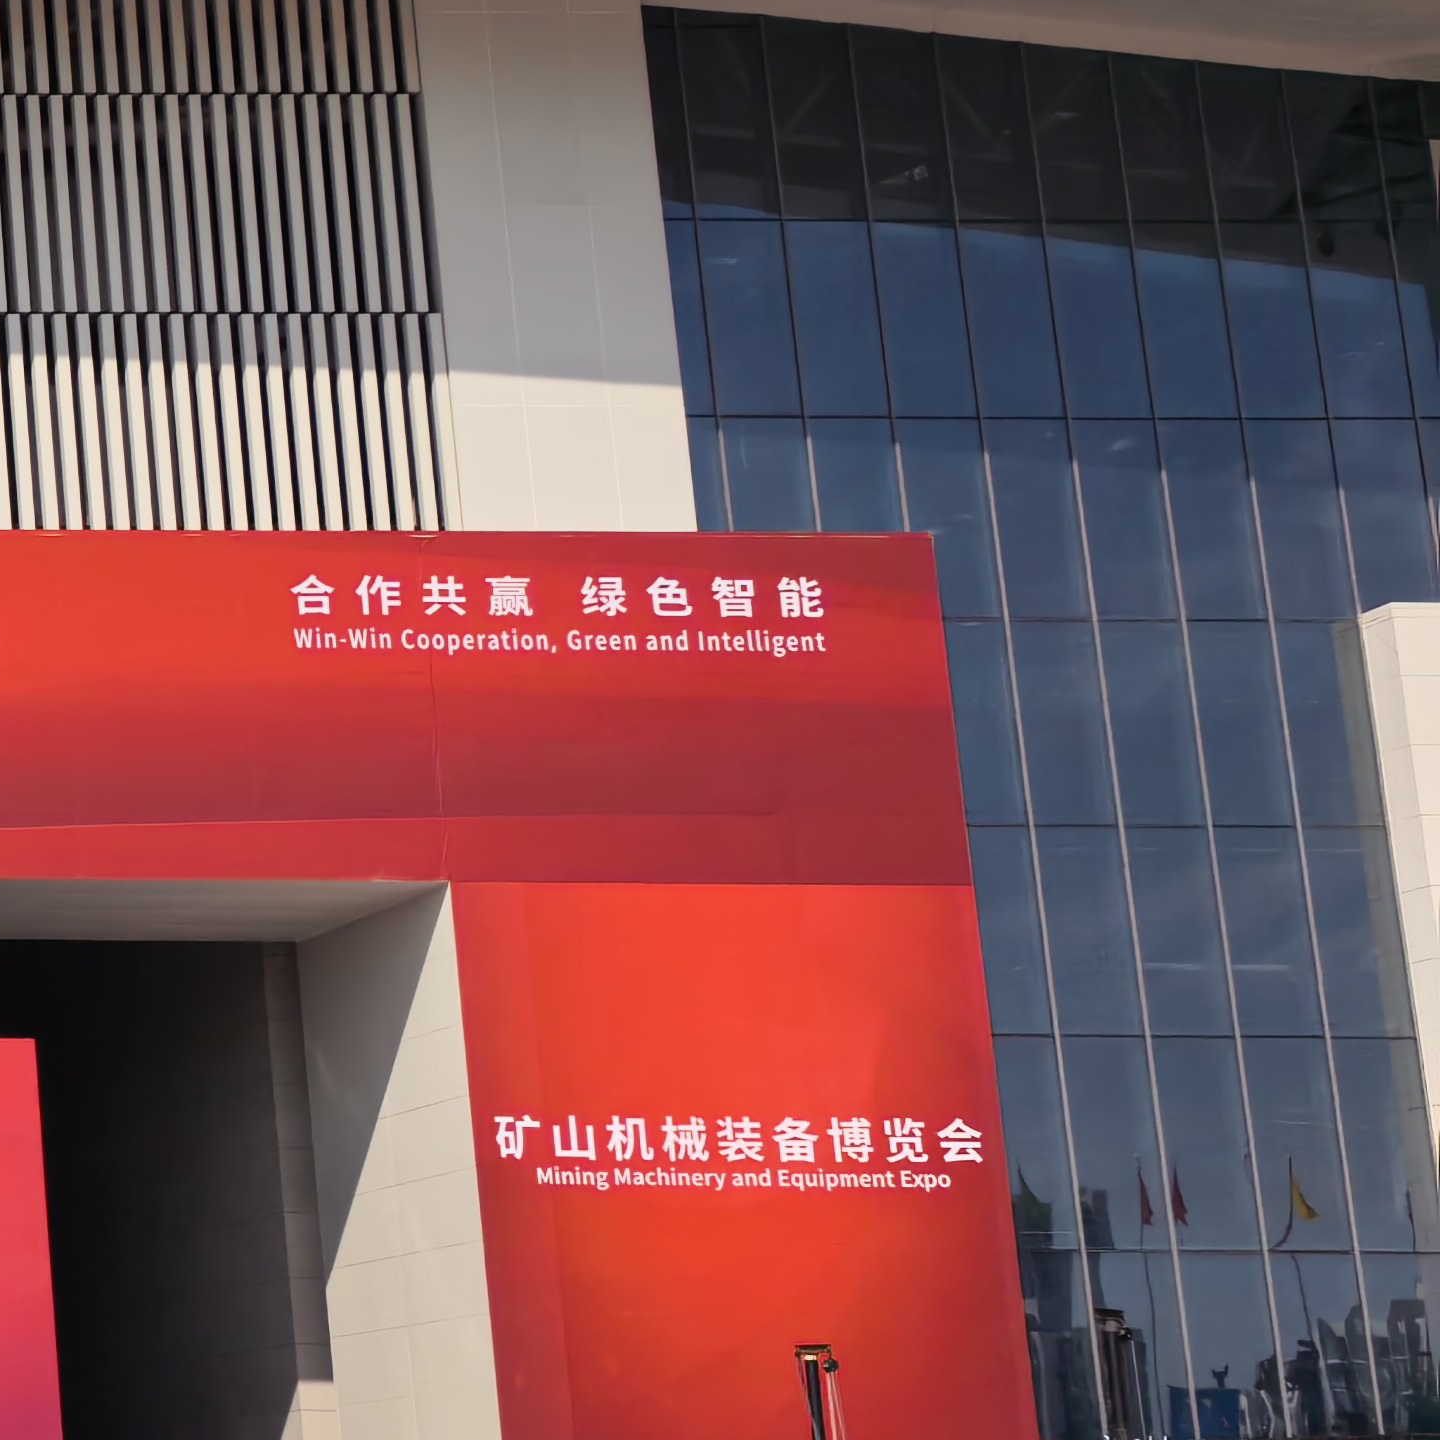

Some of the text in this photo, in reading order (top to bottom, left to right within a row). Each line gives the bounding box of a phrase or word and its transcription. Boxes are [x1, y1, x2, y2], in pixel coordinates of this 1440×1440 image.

[291, 575, 824, 617] 合作共赢 绿色智能
[294, 628, 826, 657] Win-Win Cooperation, Green and Intelligent
[494, 1115, 983, 1163] 矿山机械装备博览会
[537, 1166, 951, 1192] Mining Machinery and Equipment Expo
